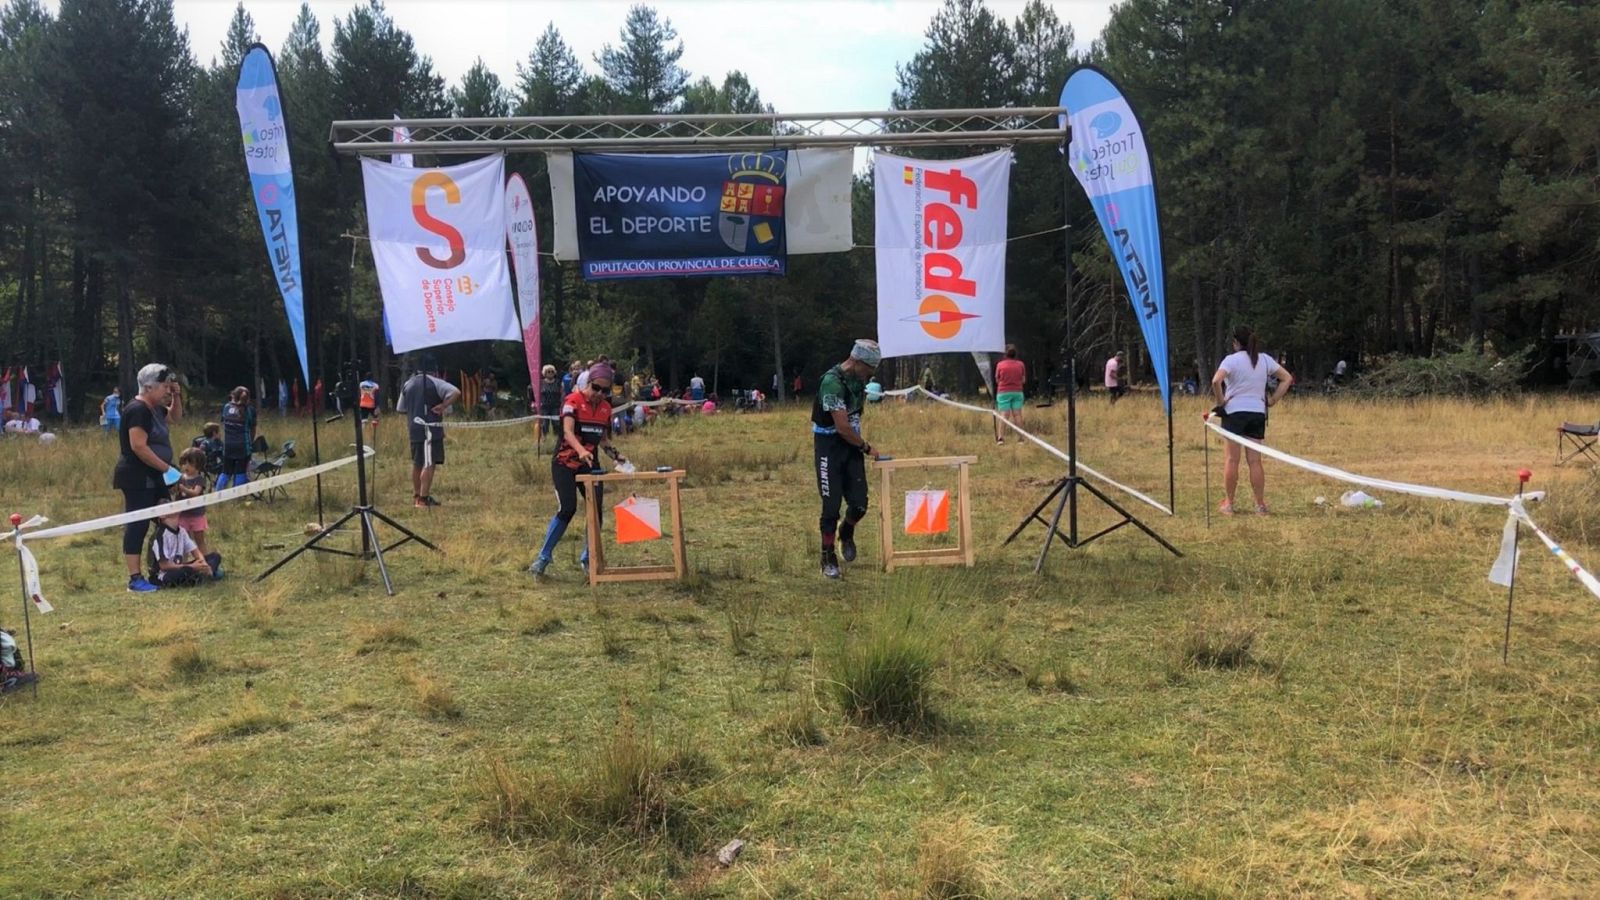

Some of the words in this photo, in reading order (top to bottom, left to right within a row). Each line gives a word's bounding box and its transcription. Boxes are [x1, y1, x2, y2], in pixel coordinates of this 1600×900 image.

[593, 185, 707, 203] APOYANDO
[914, 167, 923, 211] Federación
[411, 171, 466, 270] S
[589, 216, 613, 234] EL
[622, 215, 712, 233] DEPORTE
[914, 213, 923, 250] Española
[589, 258, 656, 274] DIPUTACIÓN
[657, 258, 718, 271] PROVINCIAL
[720, 258, 736, 270] DE
[738, 256, 780, 269] CUENCA
[421, 279, 431, 290] de
[432, 279, 445, 315] Superior
[443, 278, 455, 312] Consejo
[423, 292, 436, 333] Deportes
[820, 456, 830, 498] TRIMTEX
